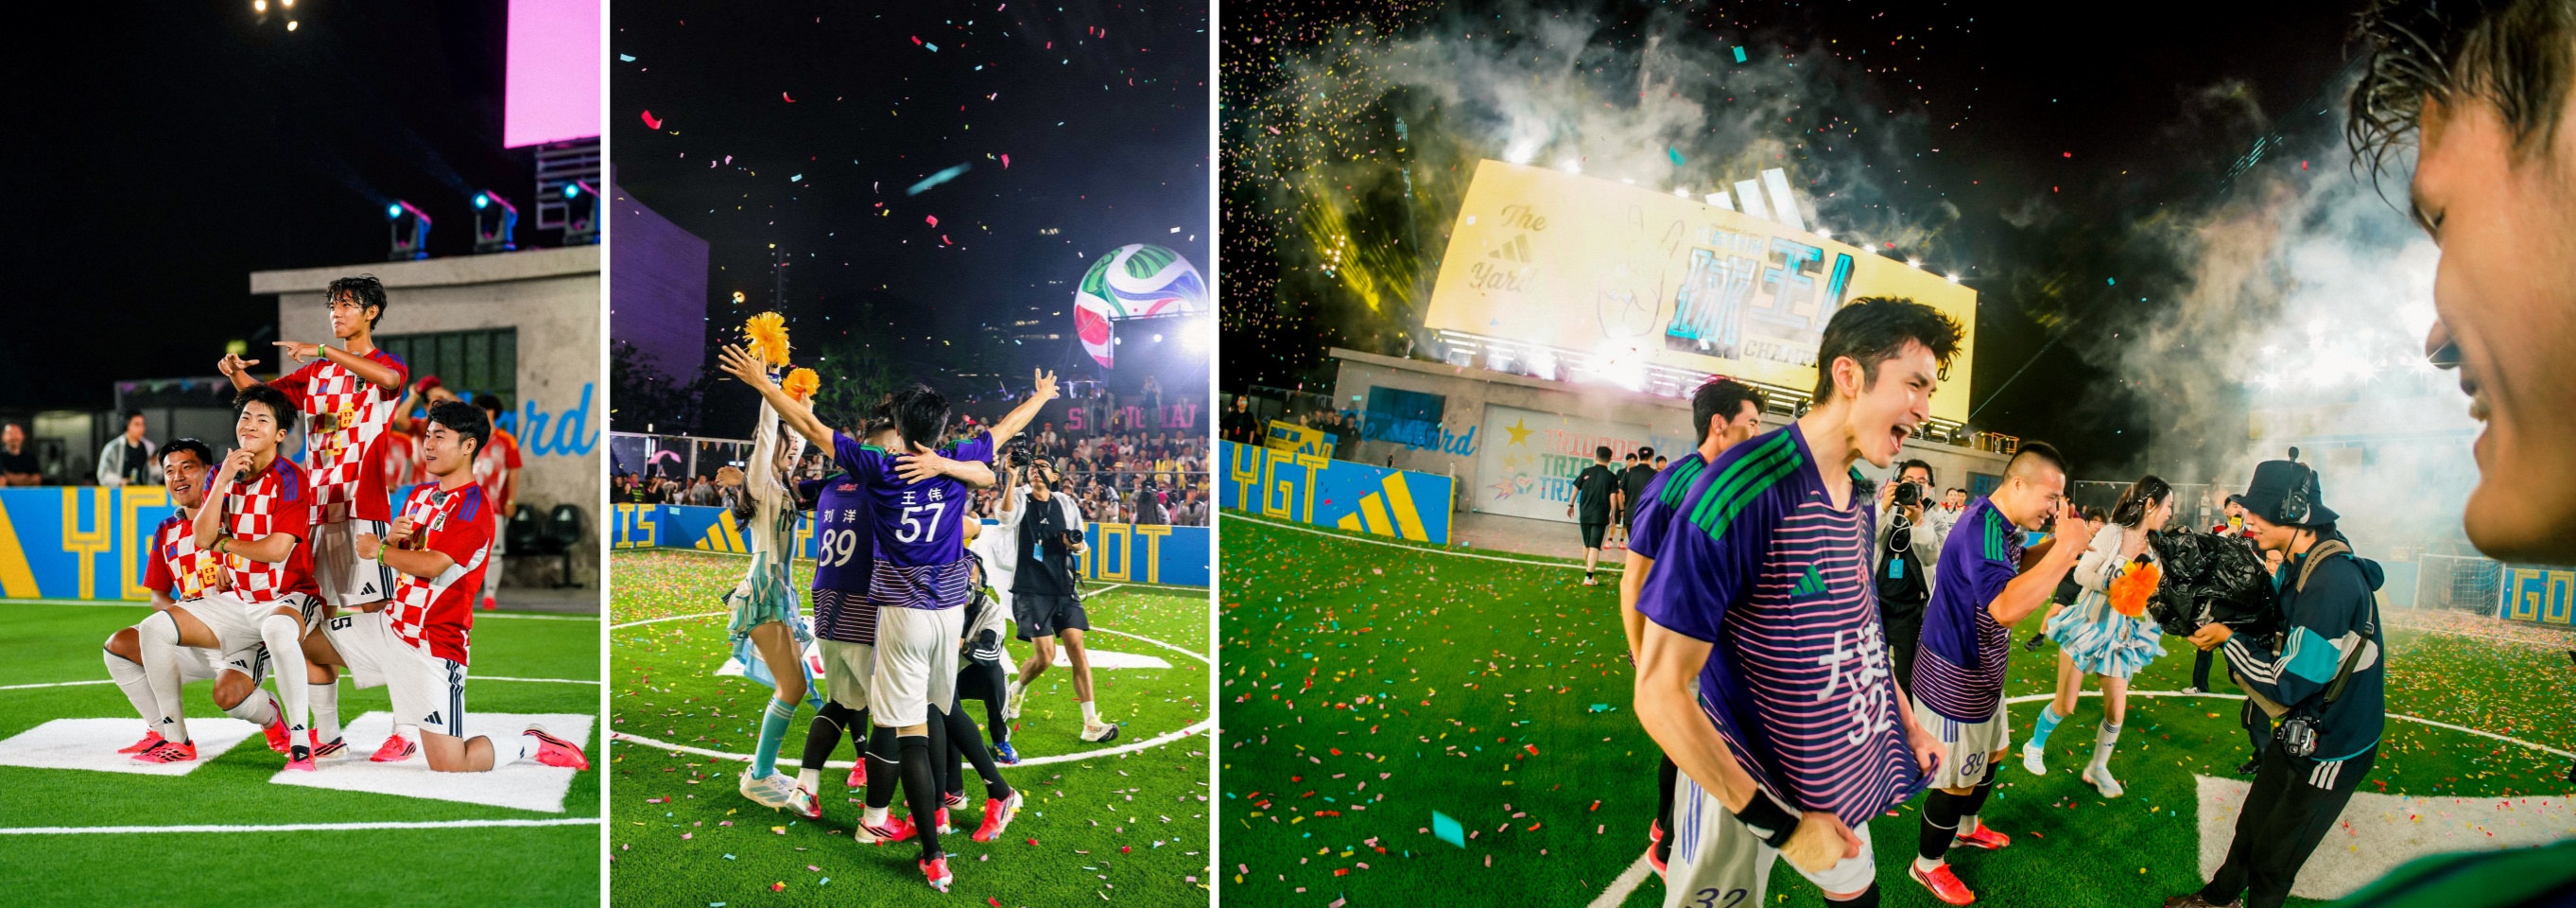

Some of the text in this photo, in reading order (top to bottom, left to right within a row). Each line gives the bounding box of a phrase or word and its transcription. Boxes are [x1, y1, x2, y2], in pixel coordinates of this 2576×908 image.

[901, 487, 944, 506] 王伟
[1231, 442, 1329, 524] YGT
[62, 485, 180, 601] YG
[610, 502, 656, 549] IS
[895, 503, 946, 543] 57
[820, 528, 857, 568] 89
[1817, 621, 1889, 702] 大连
[1847, 683, 1892, 746] 32
[1960, 751, 1986, 777] 89
